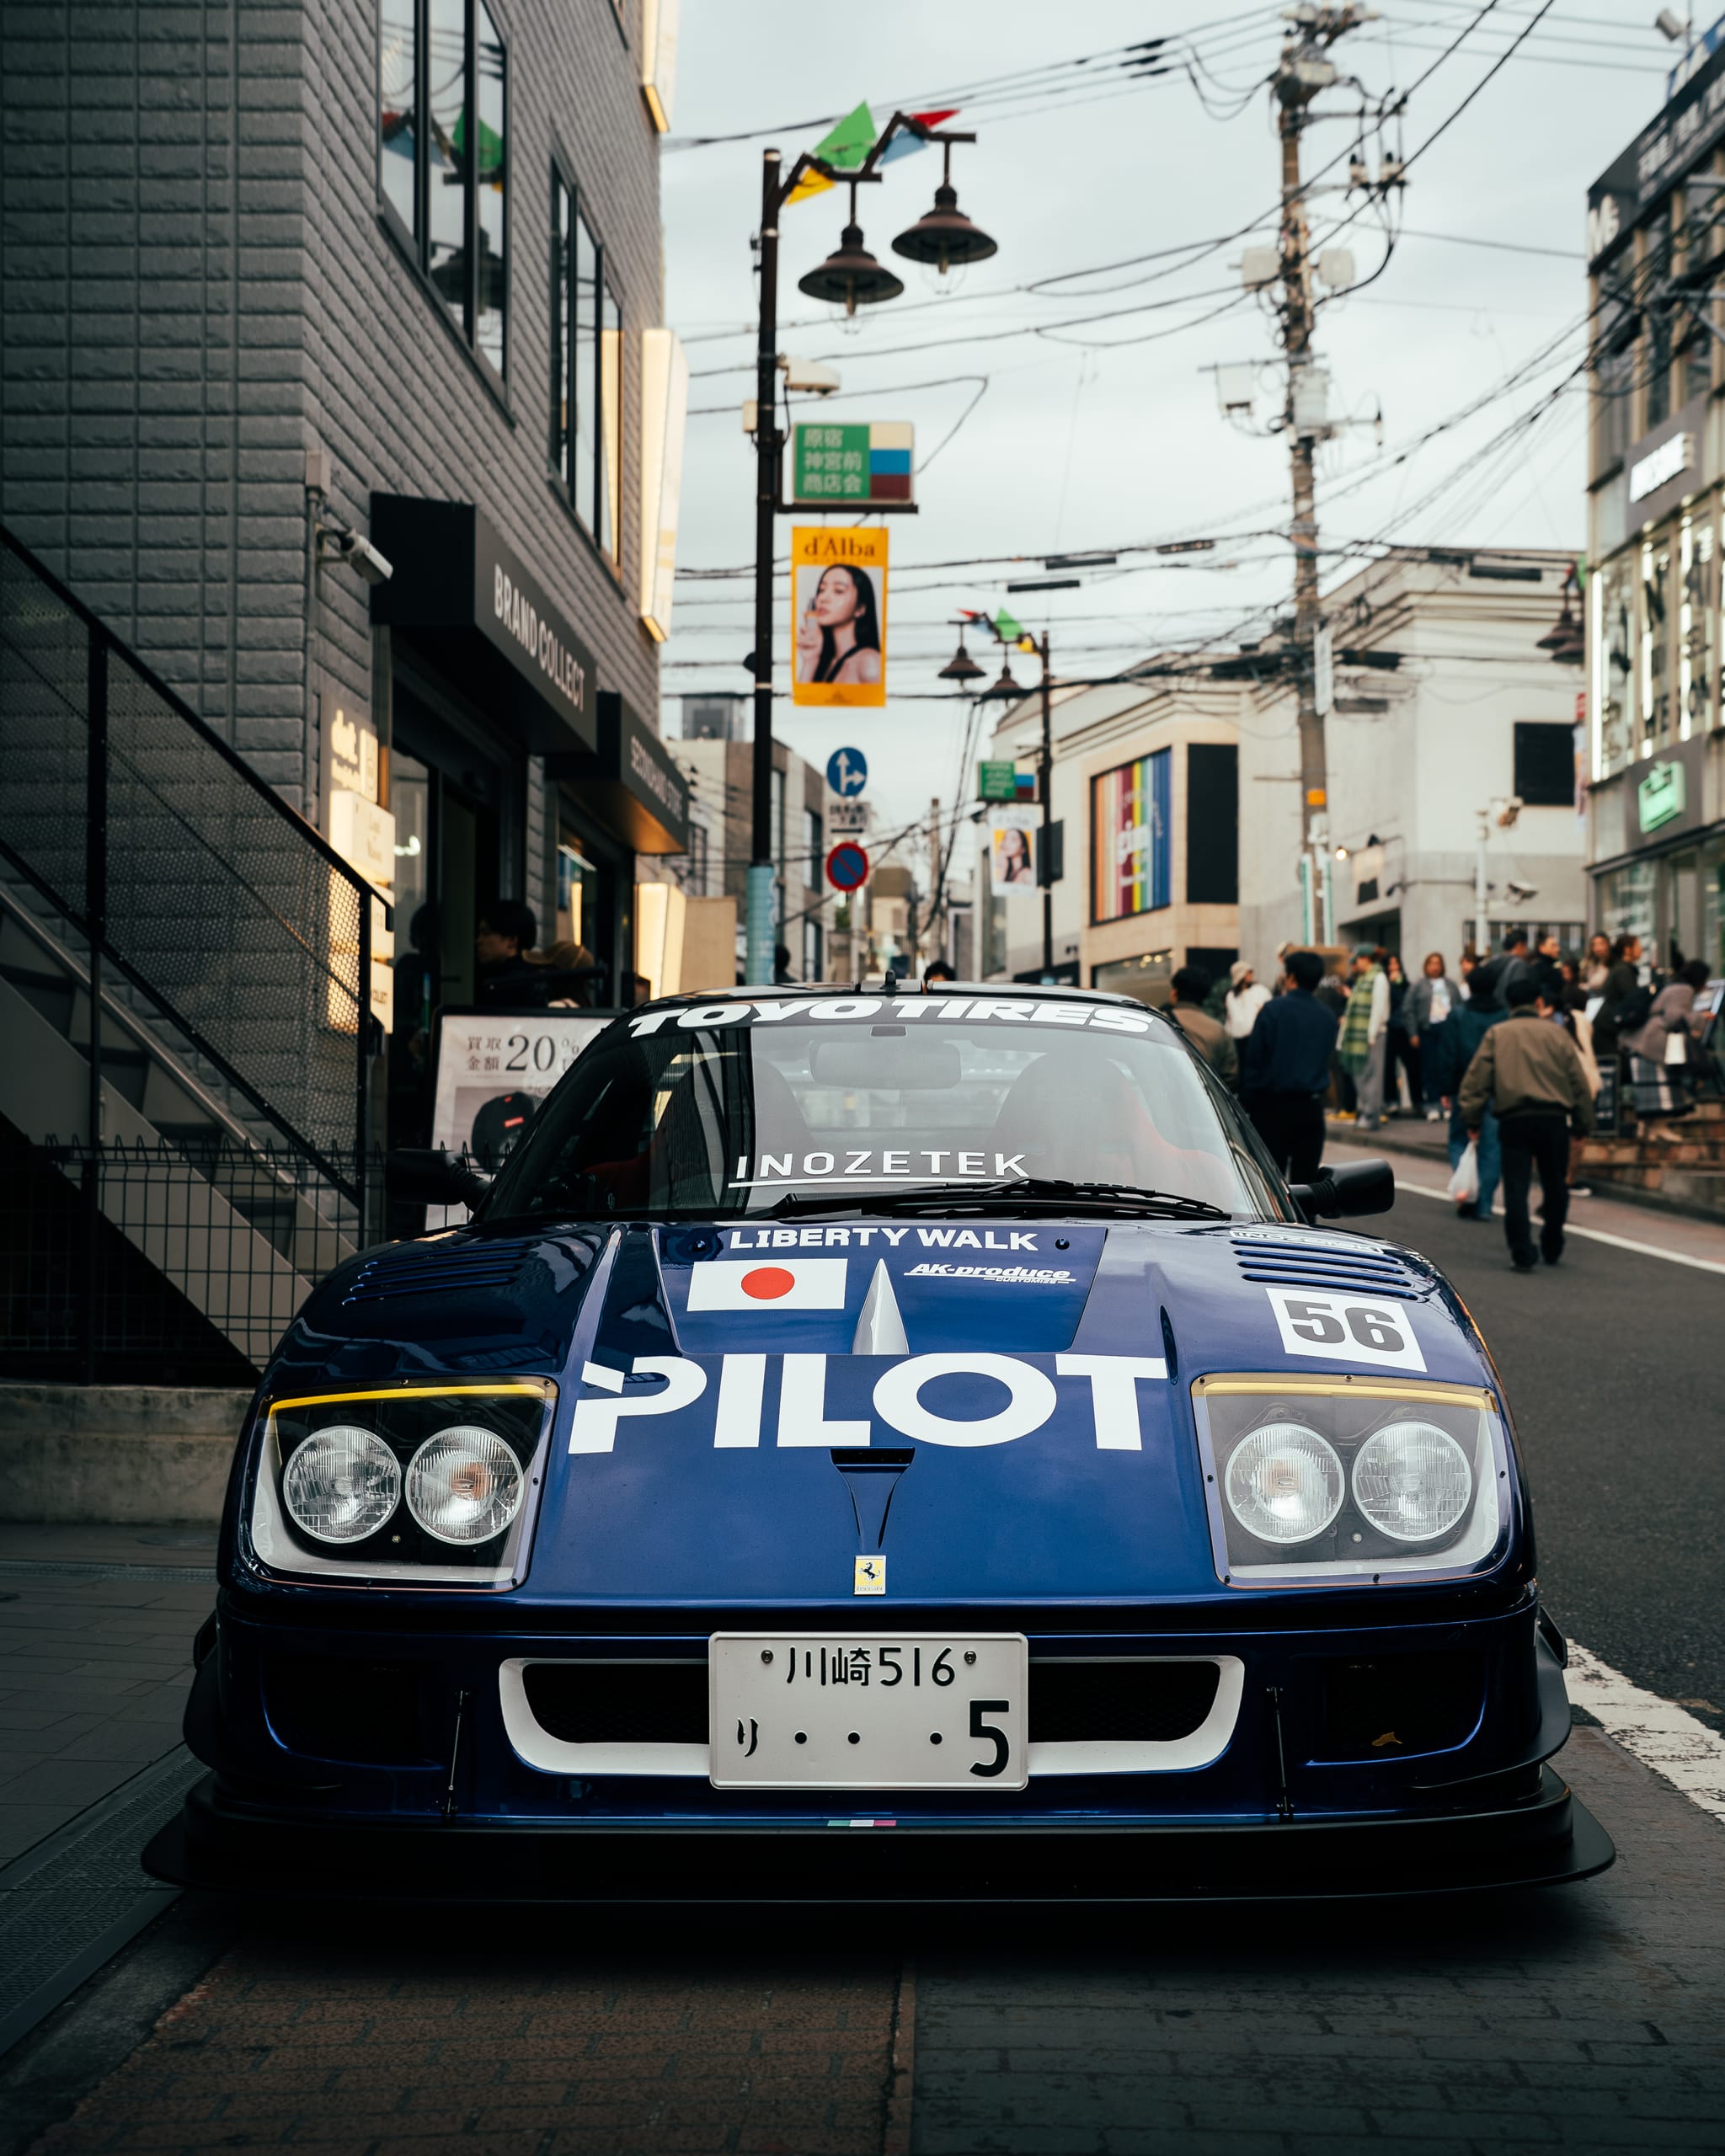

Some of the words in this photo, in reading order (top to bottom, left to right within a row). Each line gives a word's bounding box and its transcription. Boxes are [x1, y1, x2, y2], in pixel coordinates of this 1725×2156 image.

[804, 429, 842, 448] 原宿
[805, 451, 862, 472] 神宮前
[804, 473, 862, 494] 商店会
[804, 536, 875, 558] d'Alba
[494, 563, 538, 659] BRAND
[538, 620, 585, 712] COLLECT
[628, 999, 883, 1038] TOYO
[890, 999, 1154, 1033] TIRES
[467, 1037, 502, 1052] 買取
[467, 1056, 499, 1071] 金額
[736, 1150, 1029, 1179] INOZETEK
[729, 1228, 910, 1249] LIBERTY
[916, 1228, 1039, 1251] WALK
[910, 1262, 1071, 1278] AK-produce
[1283, 1299, 1405, 1353] 56
[569, 1353, 1168, 1454] PILOT
